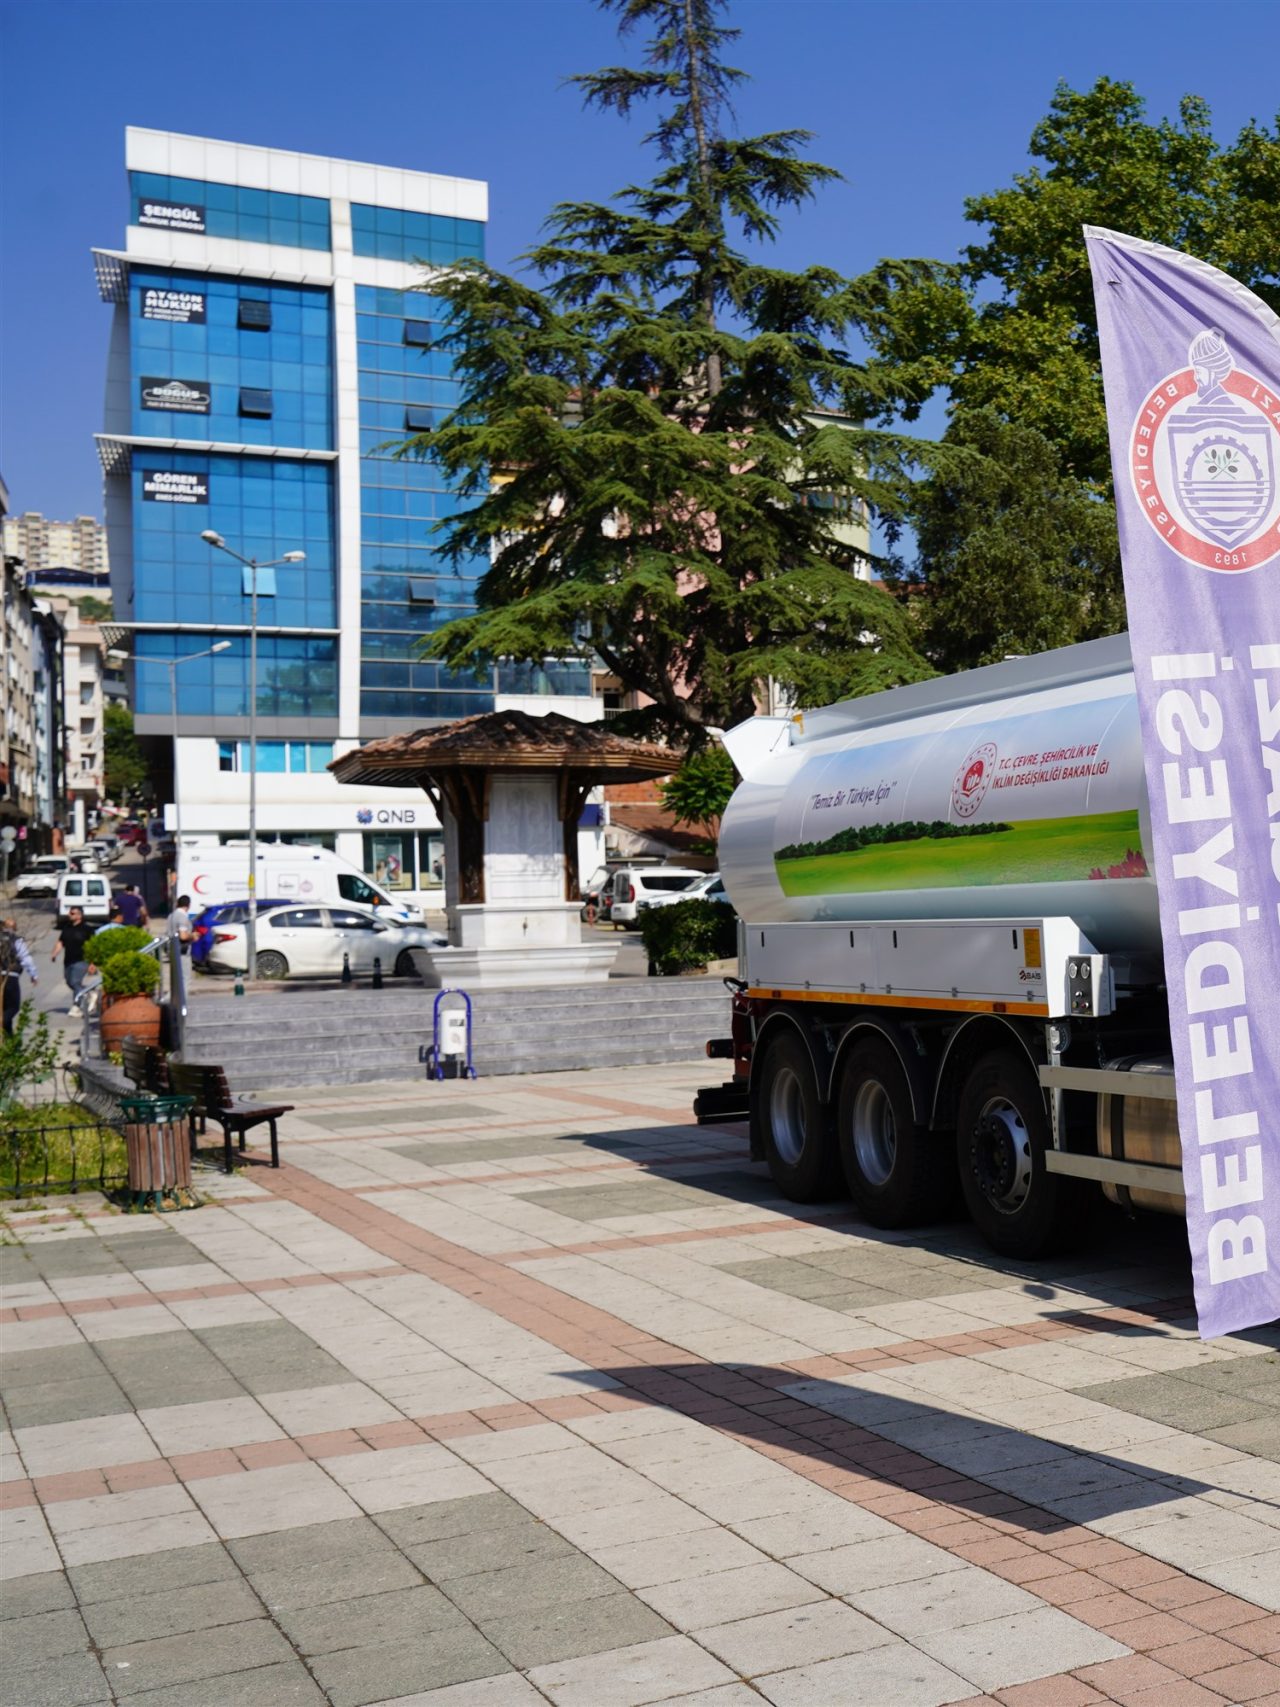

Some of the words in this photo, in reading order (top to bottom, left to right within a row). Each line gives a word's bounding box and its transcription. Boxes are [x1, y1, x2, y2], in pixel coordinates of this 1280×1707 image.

[143, 204, 201, 221] ŞENGÜL
[145, 290, 202, 303] AYGÜN
[145, 298, 204, 312] HUKUK
[153, 472, 197, 485] GÖREN
[144, 481, 207, 495] MİMARLIK
[999, 758, 1011, 770] T.C.
[1040, 744, 1086, 767] ŞEHİRCİLİK
[1086, 743, 1099, 757] VE
[992, 771, 1014, 789] İKLİM
[1014, 765, 1063, 787] DEĞİŞİKLİĞİ
[1062, 759, 1110, 780] BAKANLIĞI
[833, 790, 846, 807] Bir
[847, 786, 874, 808] Türkiye
[377, 809, 416, 824] QNB
